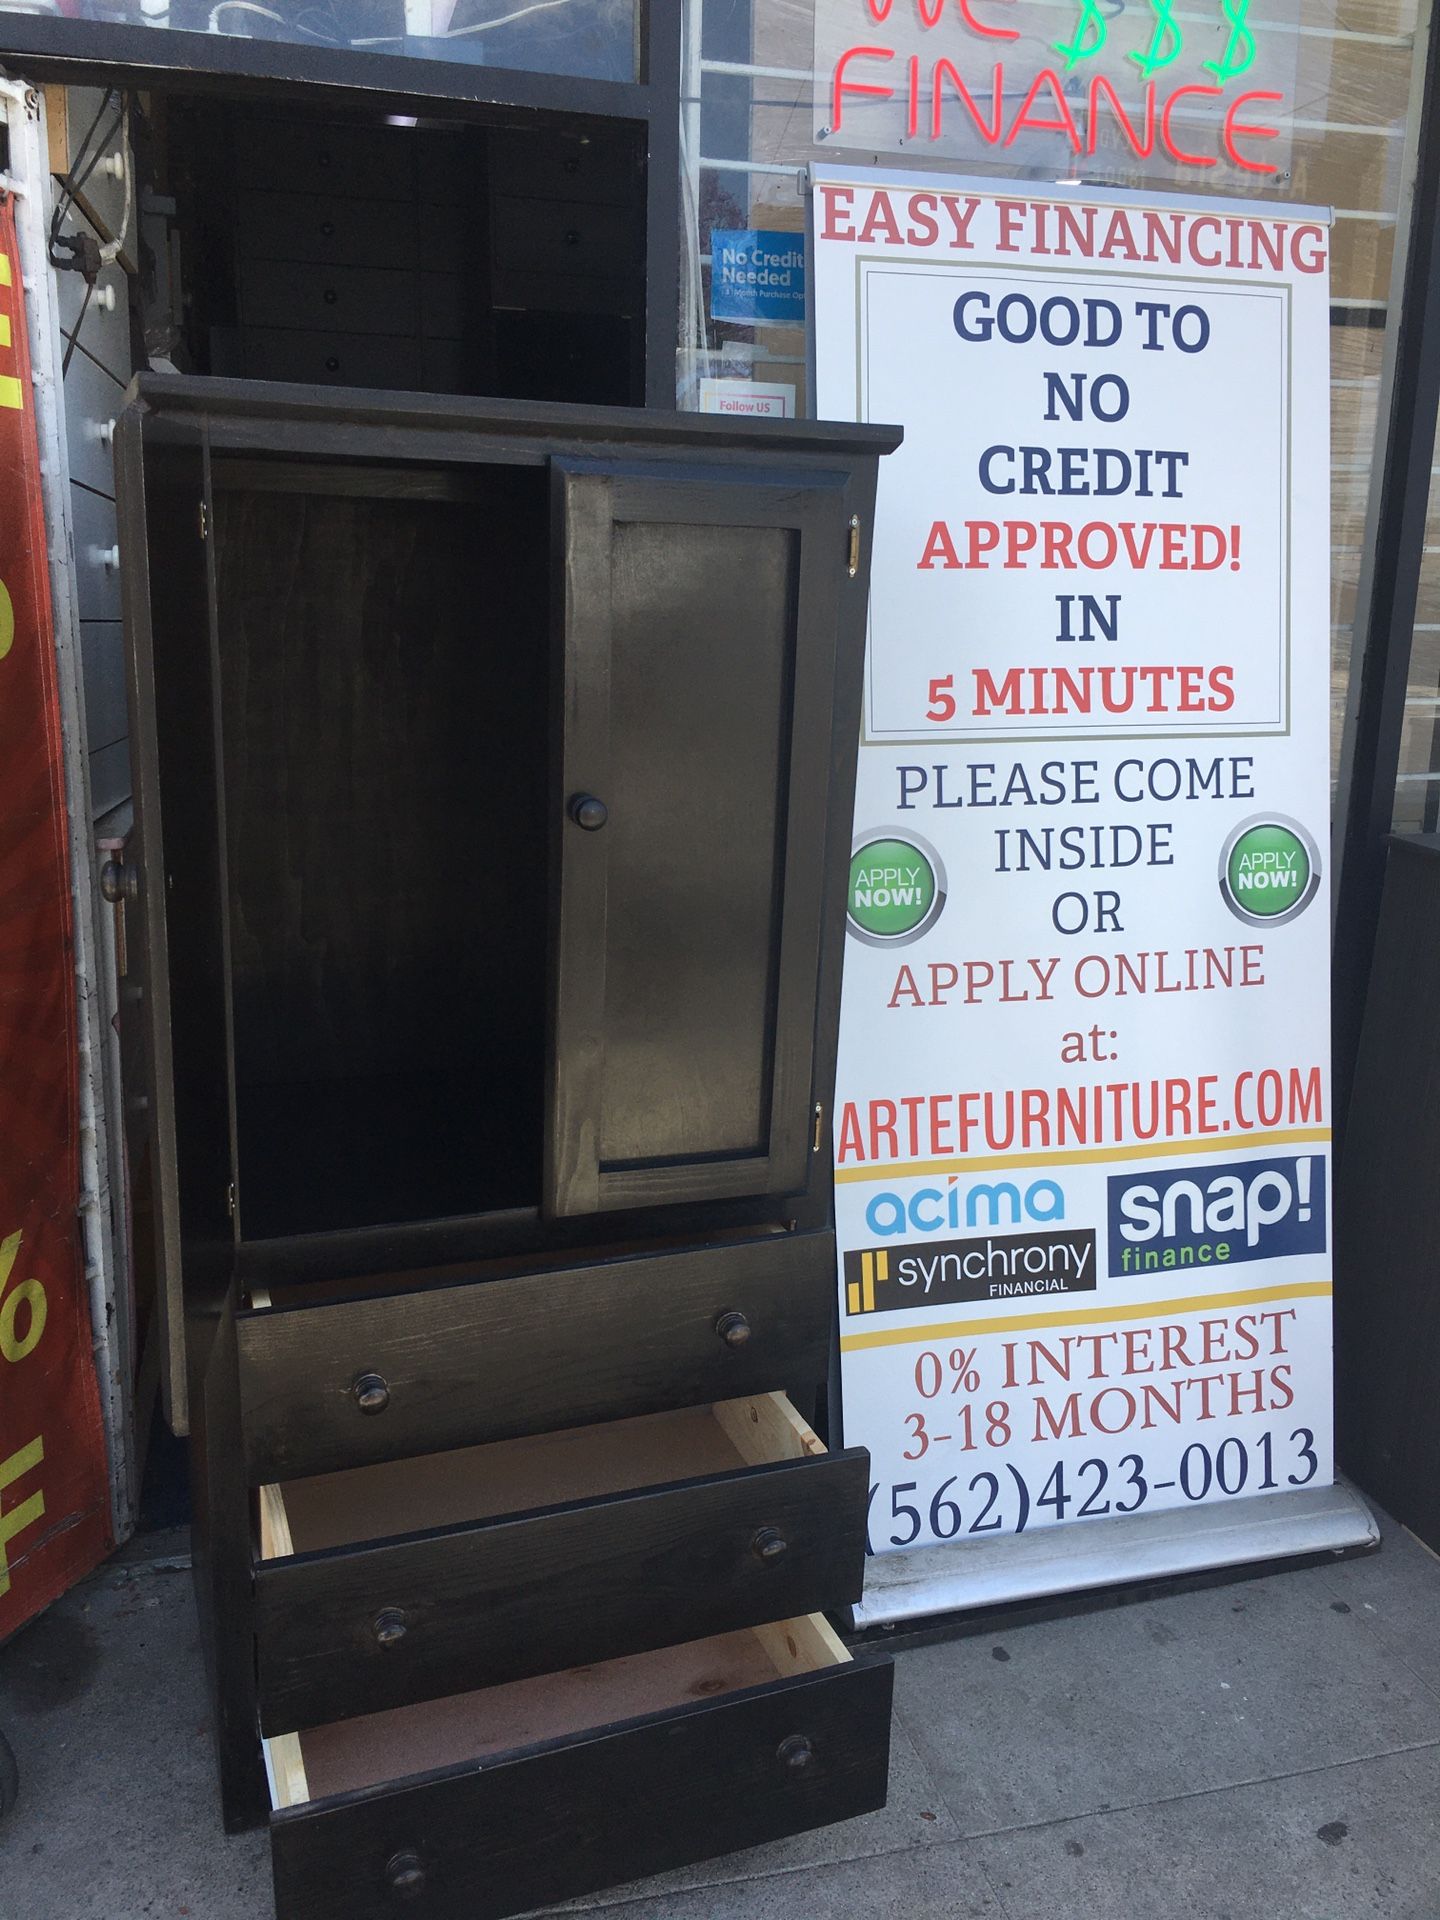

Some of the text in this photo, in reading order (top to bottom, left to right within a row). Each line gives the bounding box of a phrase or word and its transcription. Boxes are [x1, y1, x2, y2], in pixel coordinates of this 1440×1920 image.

[832, 46, 1285, 174] FINANCE
[820, 187, 1328, 274] EASY FINANCING
[722, 248, 804, 268] No Credit
[722, 266, 791, 287] Needed
[953, 291, 1210, 353] GOOD TO
[720, 400, 770, 413] Follow US
[1043, 372, 1129, 422] NO
[979, 445, 1189, 498] CREDIT
[917, 521, 1240, 571] APPROVED!
[1056, 595, 1121, 641] IN
[926, 666, 1234, 721] 5 MINUTES
[896, 757, 1254, 809] PLEASE COME
[995, 824, 1173, 872] INSIDE
[1238, 850, 1296, 871] APPLY
[854, 887, 922, 908] NOW!
[855, 867, 920, 888] APPLY
[1238, 870, 1297, 890] NOW!
[1052, 891, 1124, 934] OR
[887, 945, 1264, 1008] APPLY ONLINE
[1061, 1025, 1117, 1063] at:
[838, 1067, 1323, 1163] ARTEFURNITURE.COM
[866, 1176, 1065, 1236] acima
[1119, 1156, 1312, 1247] snap!
[898, 1239, 1092, 1293] synchrony
[1121, 1241, 1231, 1272] finance
[989, 1277, 1069, 1297] FINANCIAL
[915, 1309, 1297, 1398] 0% INTEREST
[904, 1365, 1296, 1459] 3-18 MONTHS
